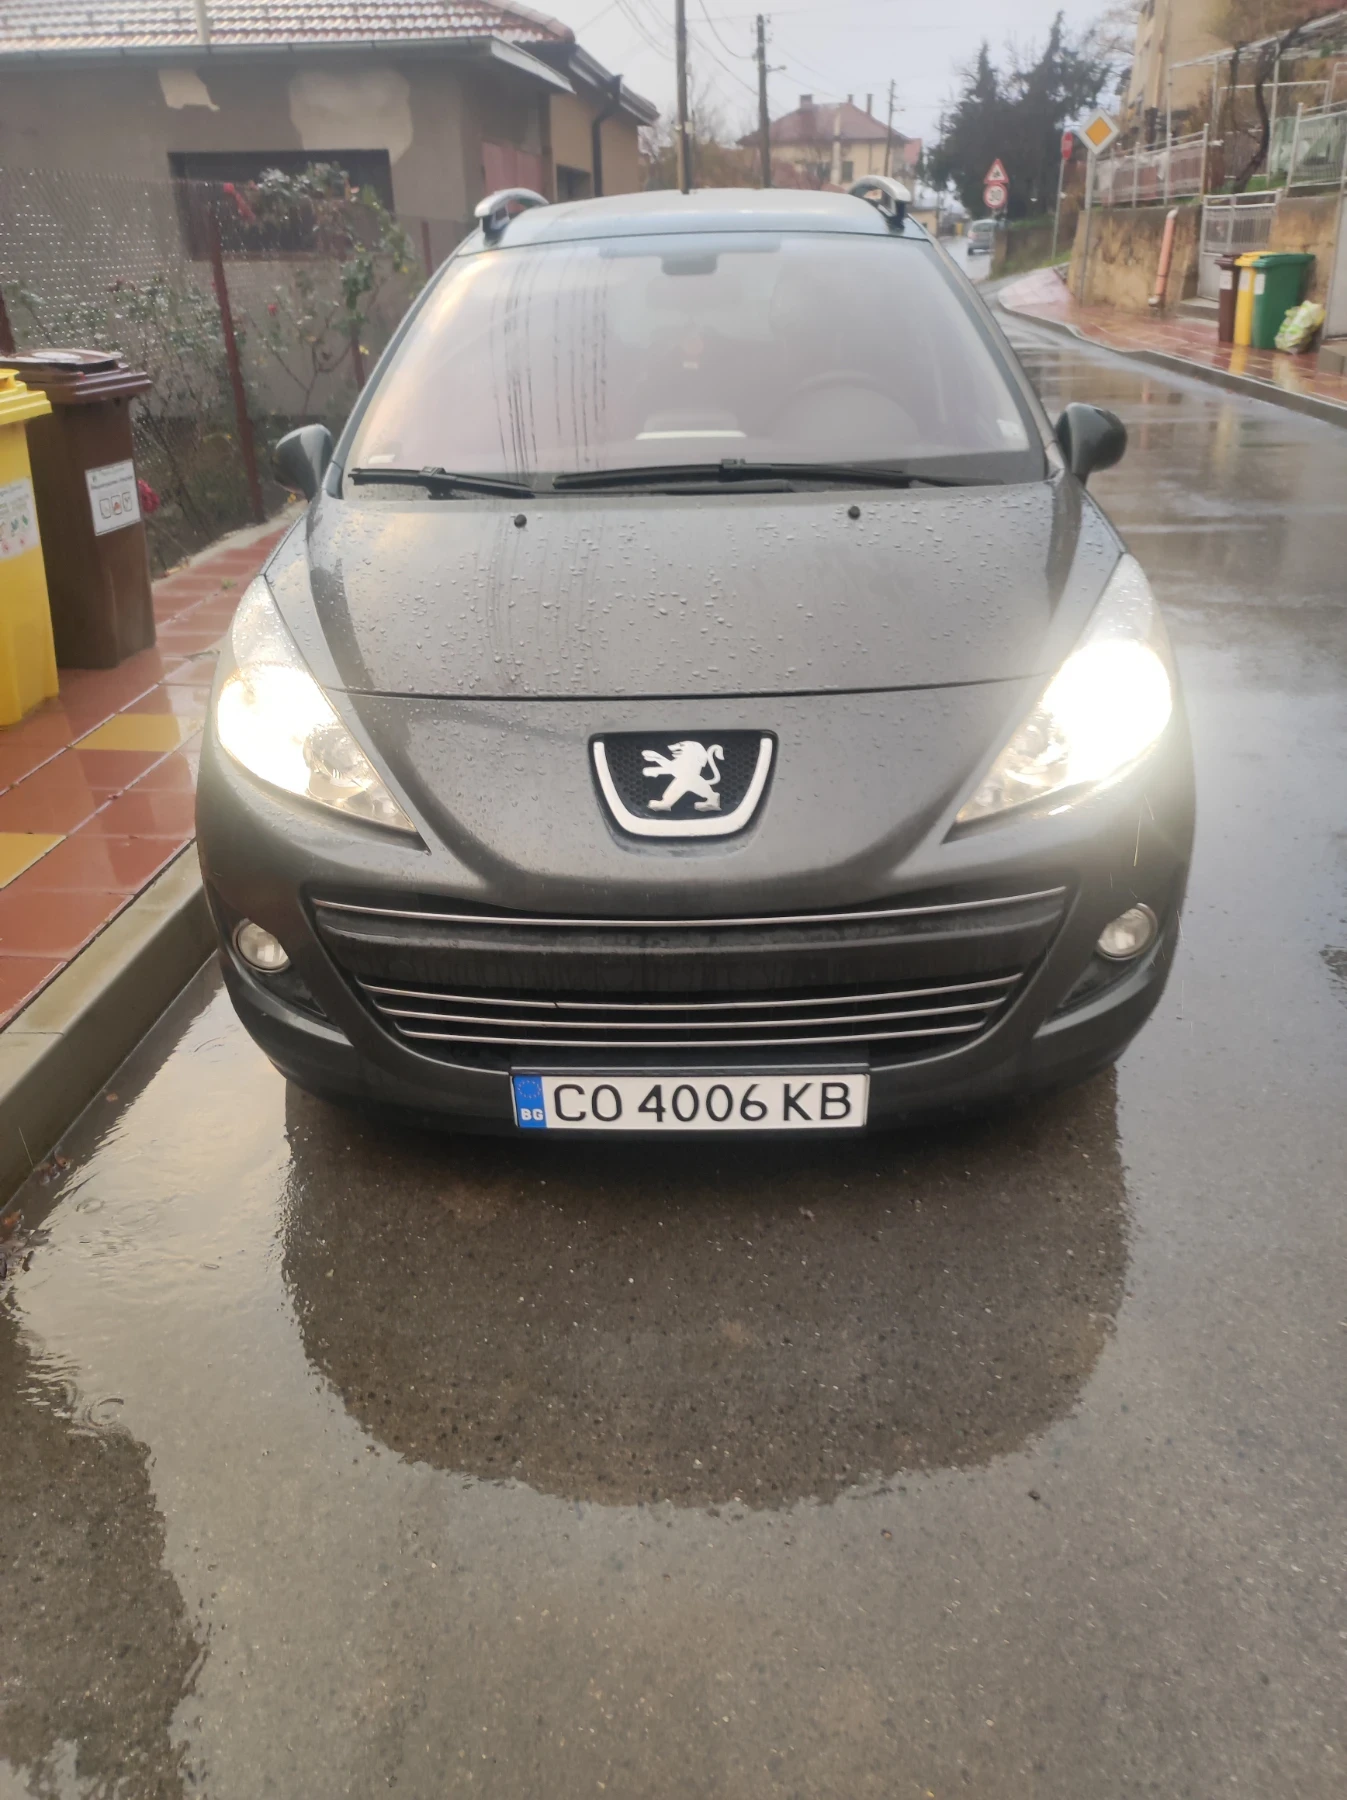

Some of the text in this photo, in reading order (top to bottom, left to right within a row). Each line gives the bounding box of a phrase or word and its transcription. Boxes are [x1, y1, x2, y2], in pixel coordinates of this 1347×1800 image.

[988, 188, 1002, 202] 30
[554, 1082, 851, 1122] CO 4006 KB
[521, 1108, 544, 1121] BG
